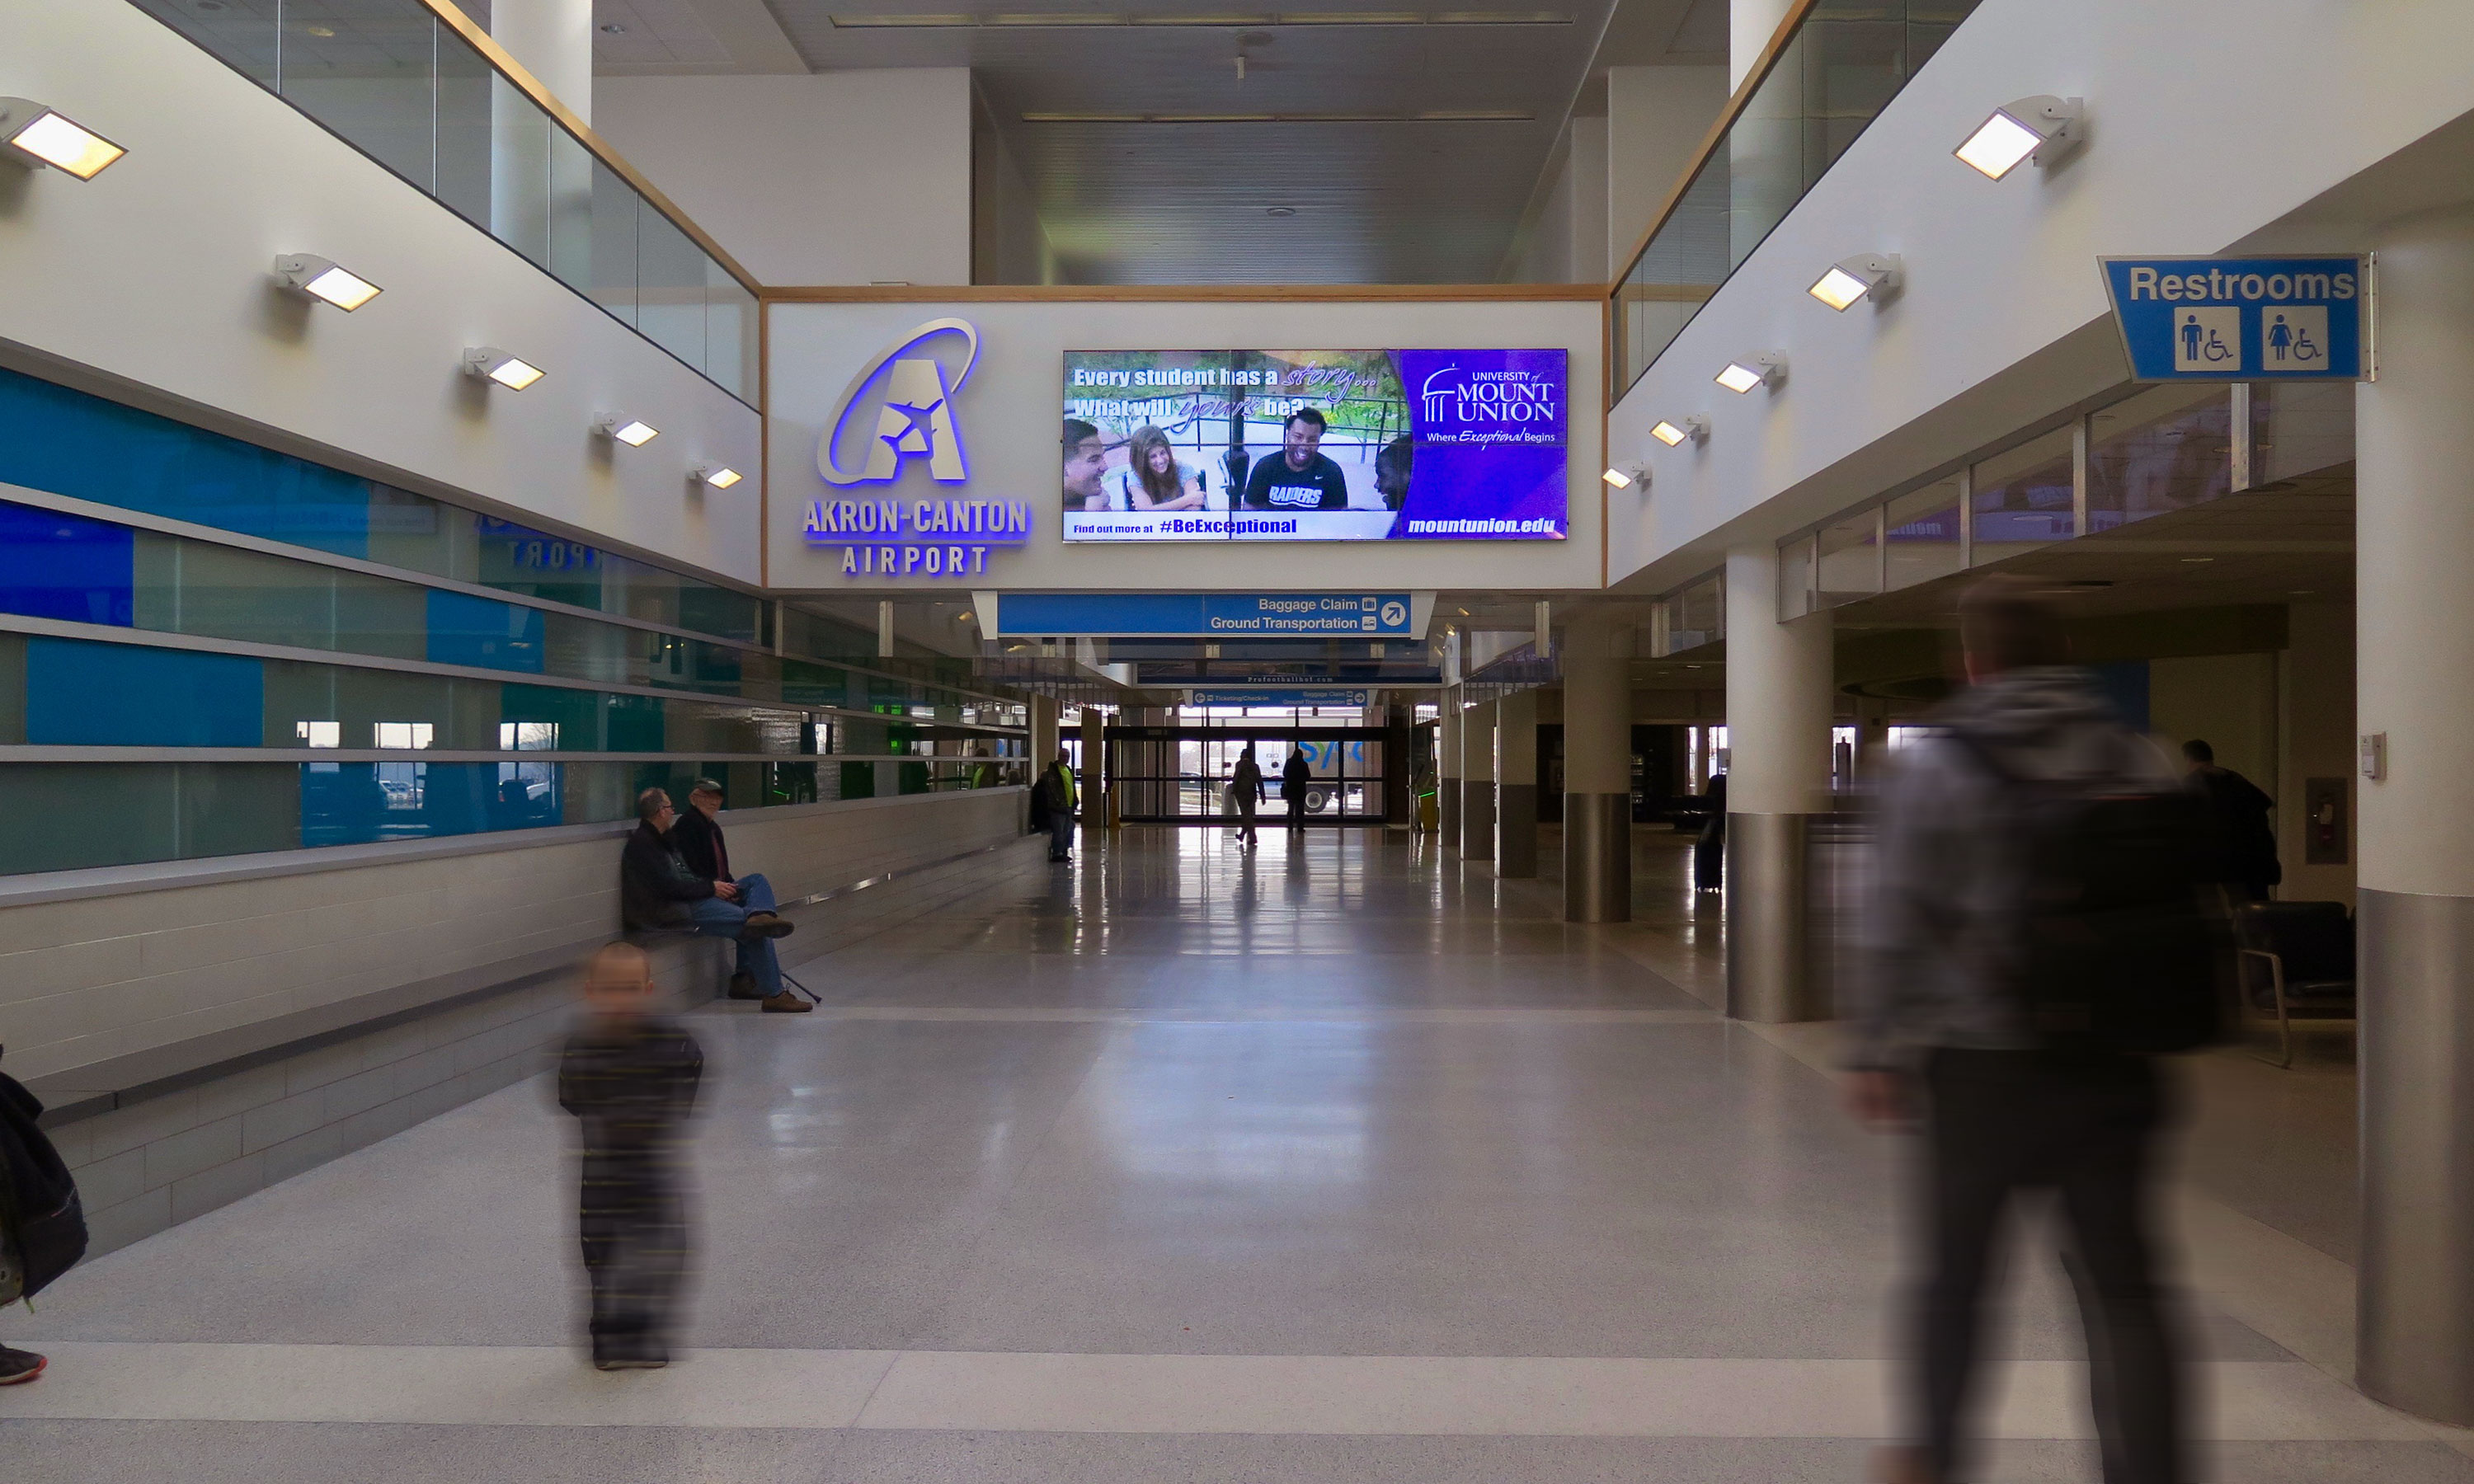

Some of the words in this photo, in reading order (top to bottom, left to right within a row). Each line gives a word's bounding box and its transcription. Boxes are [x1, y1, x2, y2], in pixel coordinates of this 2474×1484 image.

[2129, 267, 2355, 301] Restrooms
[1075, 369, 1131, 388] Every
[1135, 369, 1216, 386] student
[1221, 369, 1260, 386] has
[1265, 370, 1278, 386] a
[1472, 372, 1531, 381] UNIVERSITY
[1531, 372, 1545, 383] of
[1456, 383, 1554, 402] MOUNT
[1074, 399, 1129, 416] What
[1132, 399, 1172, 416] will
[1169, 397, 1261, 434] yours
[1264, 398, 1305, 416] be?
[1456, 402, 1554, 422] UNION
[1427, 433, 1457, 441] Where
[1459, 427, 1526, 451] Exceptional
[1525, 433, 1555, 444] Begins
[1269, 486, 1323, 505] RAIDERS
[802, 500, 1027, 533] AKRON-CANTON
[1074, 524, 1094, 533] Find
[1097, 525, 1113, 533] out
[1143, 525, 1153, 533] at
[1159, 519, 1297, 533] #BeExceptional
[1408, 518, 1555, 533] mountunion.edu
[841, 547, 986, 573] AIRPORT
[1258, 599, 1316, 613] Baggage
[1320, 599, 1358, 610] Claim
[1211, 617, 1260, 629] Ground
[1263, 617, 1358, 632] Transportation
